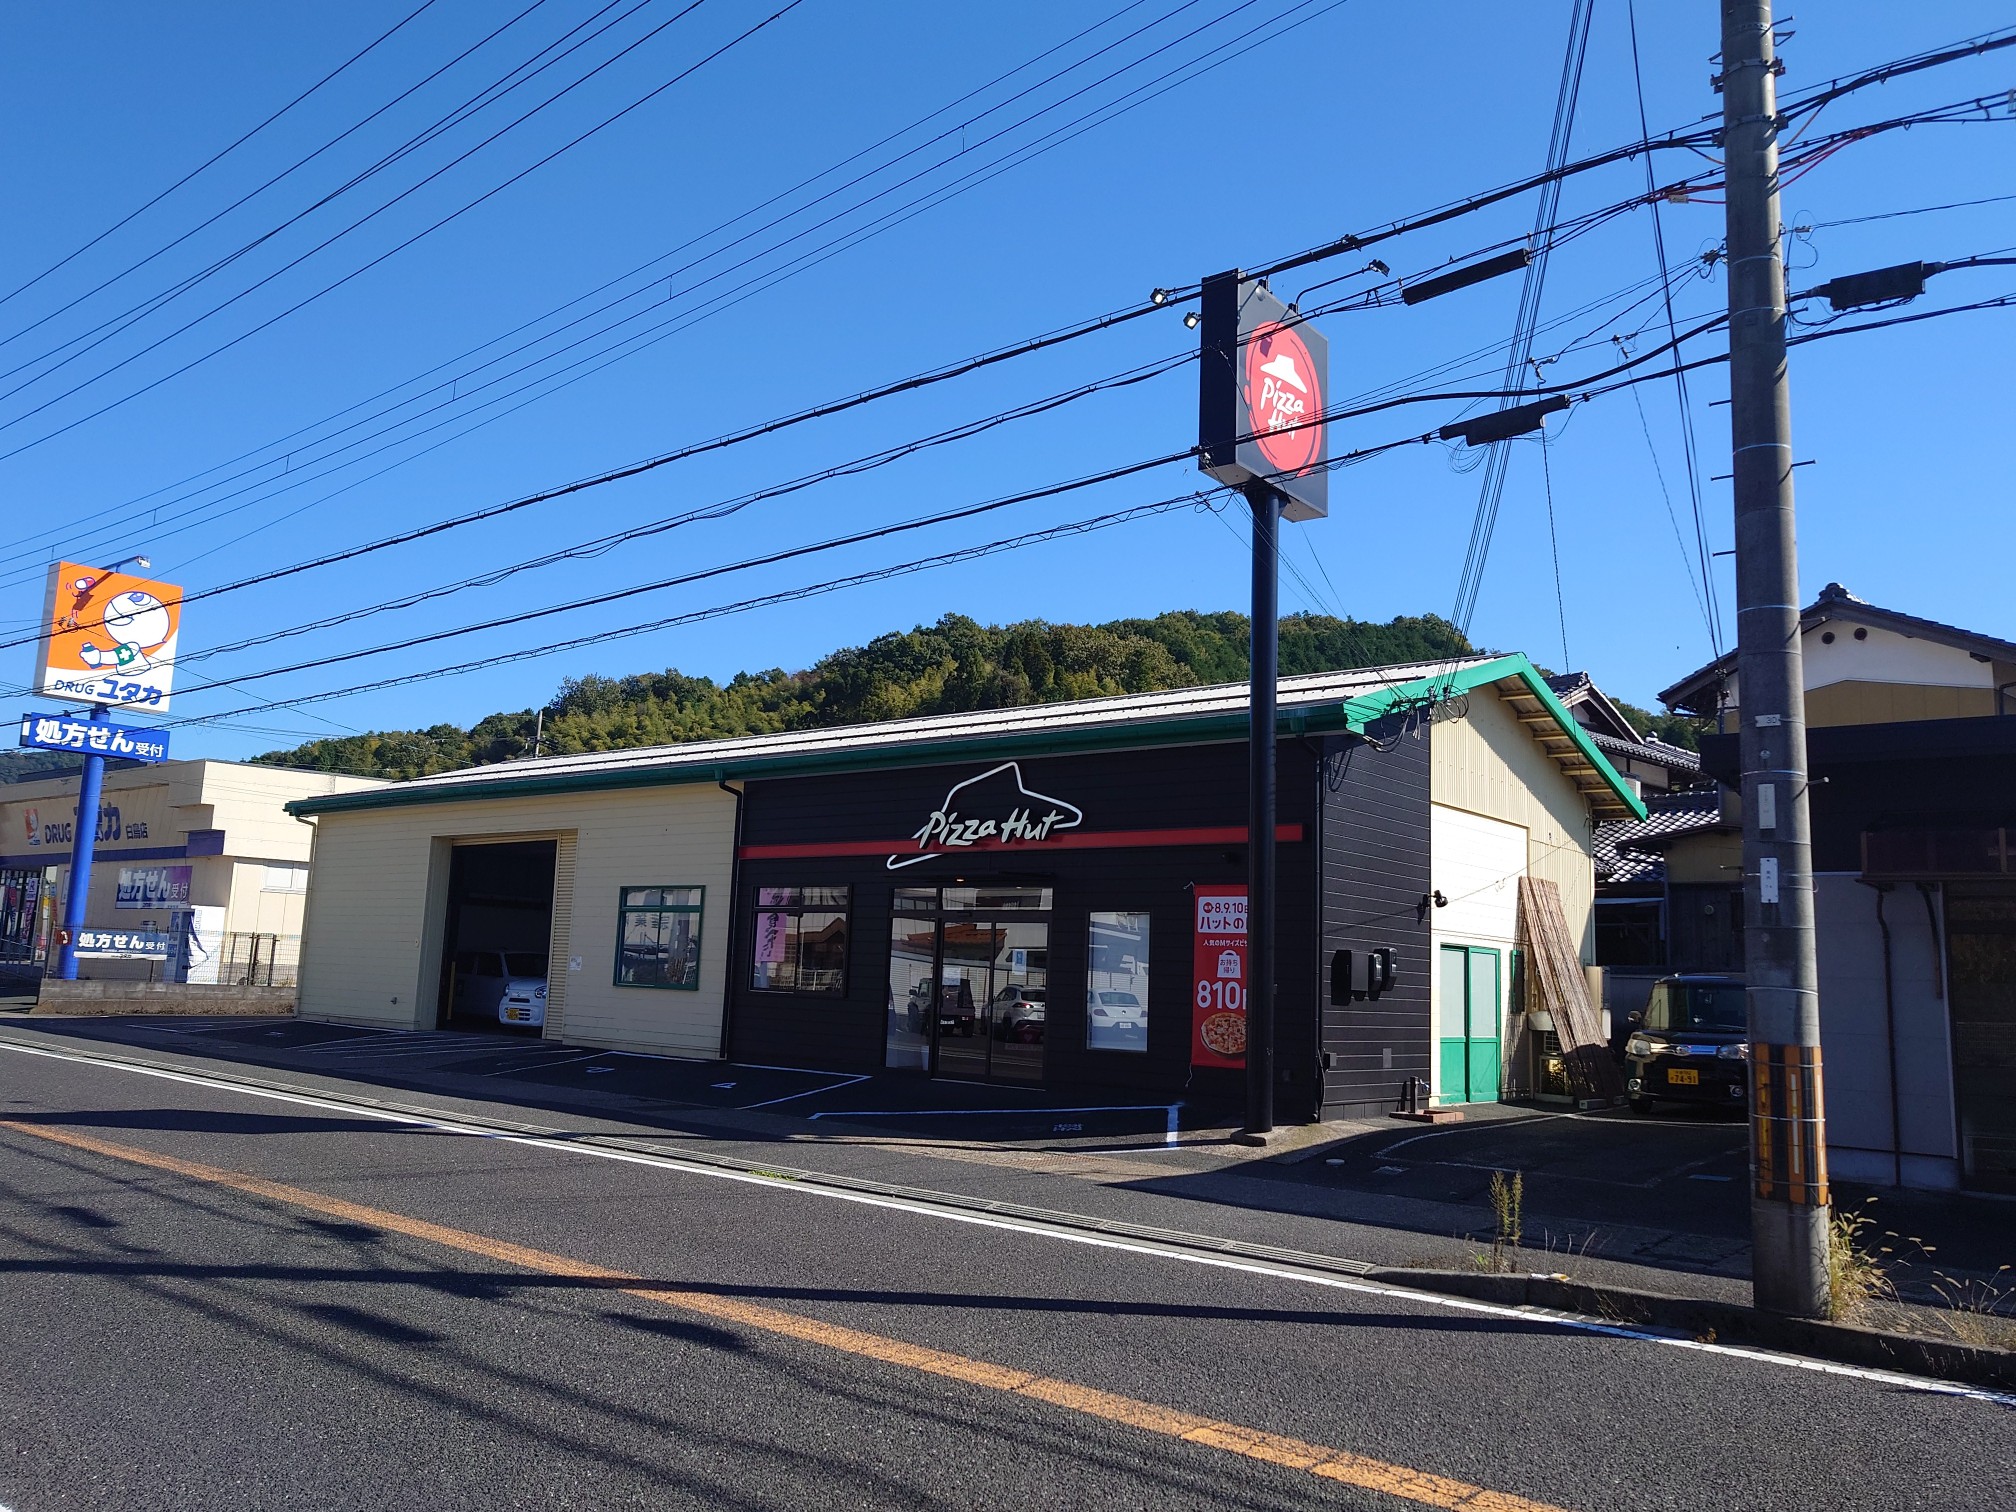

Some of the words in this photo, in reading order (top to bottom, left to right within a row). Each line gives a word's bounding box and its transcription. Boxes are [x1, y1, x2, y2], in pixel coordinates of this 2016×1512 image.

[1260, 377, 1305, 414] Pizza
[54, 679, 95, 695] DRUG
[97, 678, 163, 705] ユタカ
[44, 823, 72, 844] DRUG
[919, 811, 996, 849] Pizza
[1001, 807, 1065, 843] Hut
[1200, 916, 1248, 930] ハットの
[1197, 980, 1247, 1010] 810
